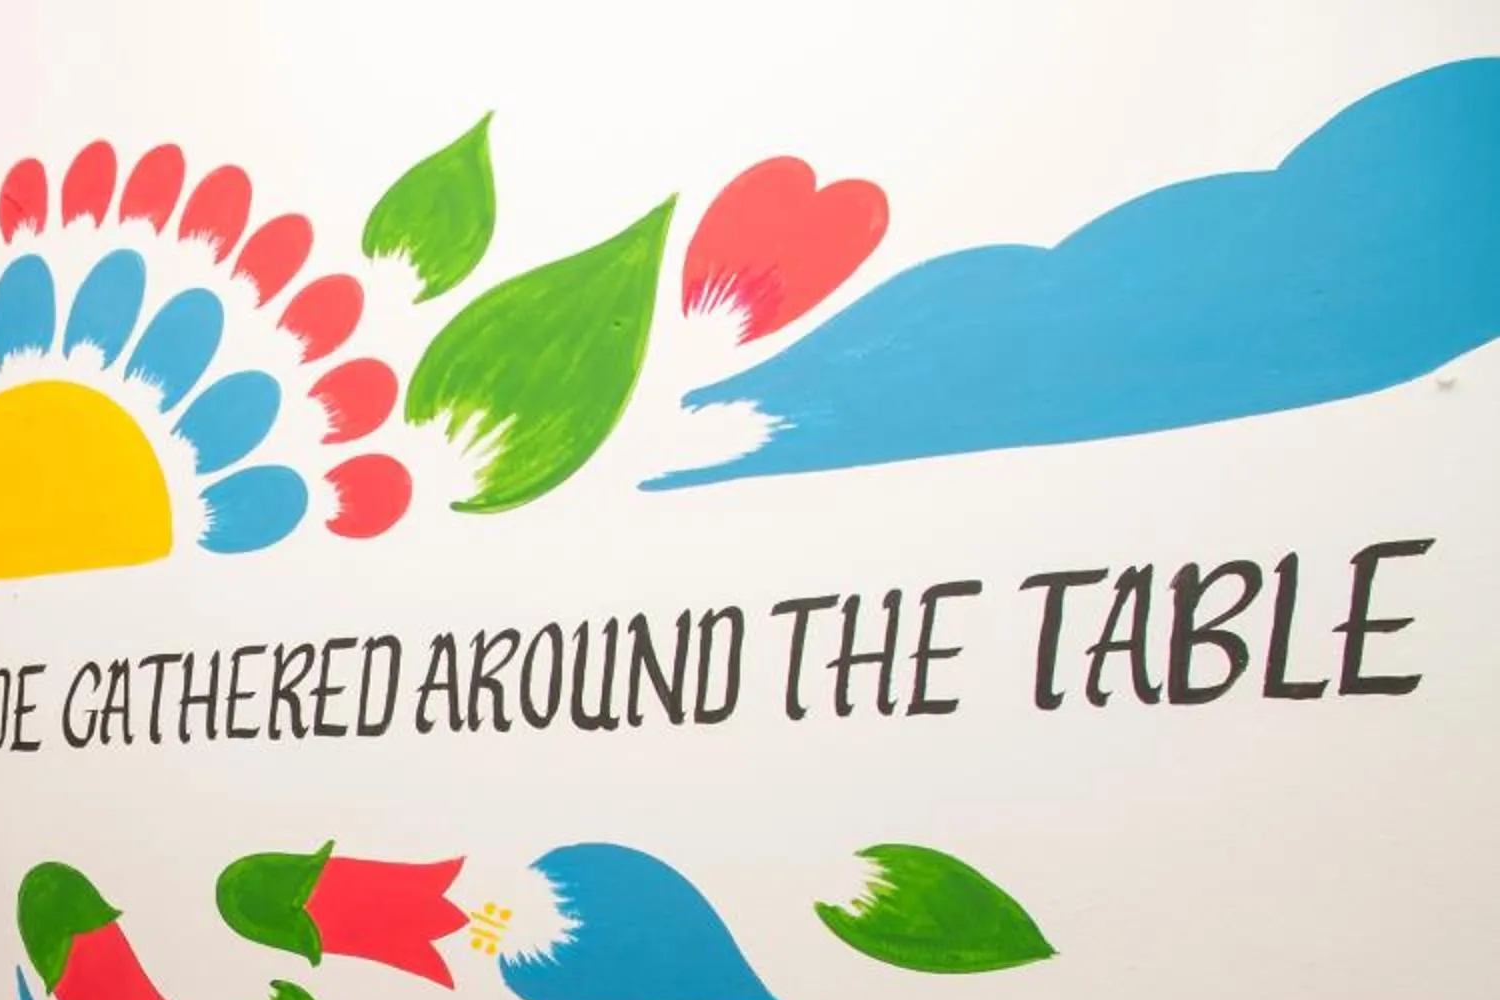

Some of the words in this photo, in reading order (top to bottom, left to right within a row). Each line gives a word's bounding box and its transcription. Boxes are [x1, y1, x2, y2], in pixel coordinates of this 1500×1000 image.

[62, 635, 402, 749] GATHERED
[415, 606, 744, 734] AROUND
[771, 580, 982, 721] THE
[1019, 538, 1435, 711] TABLE
